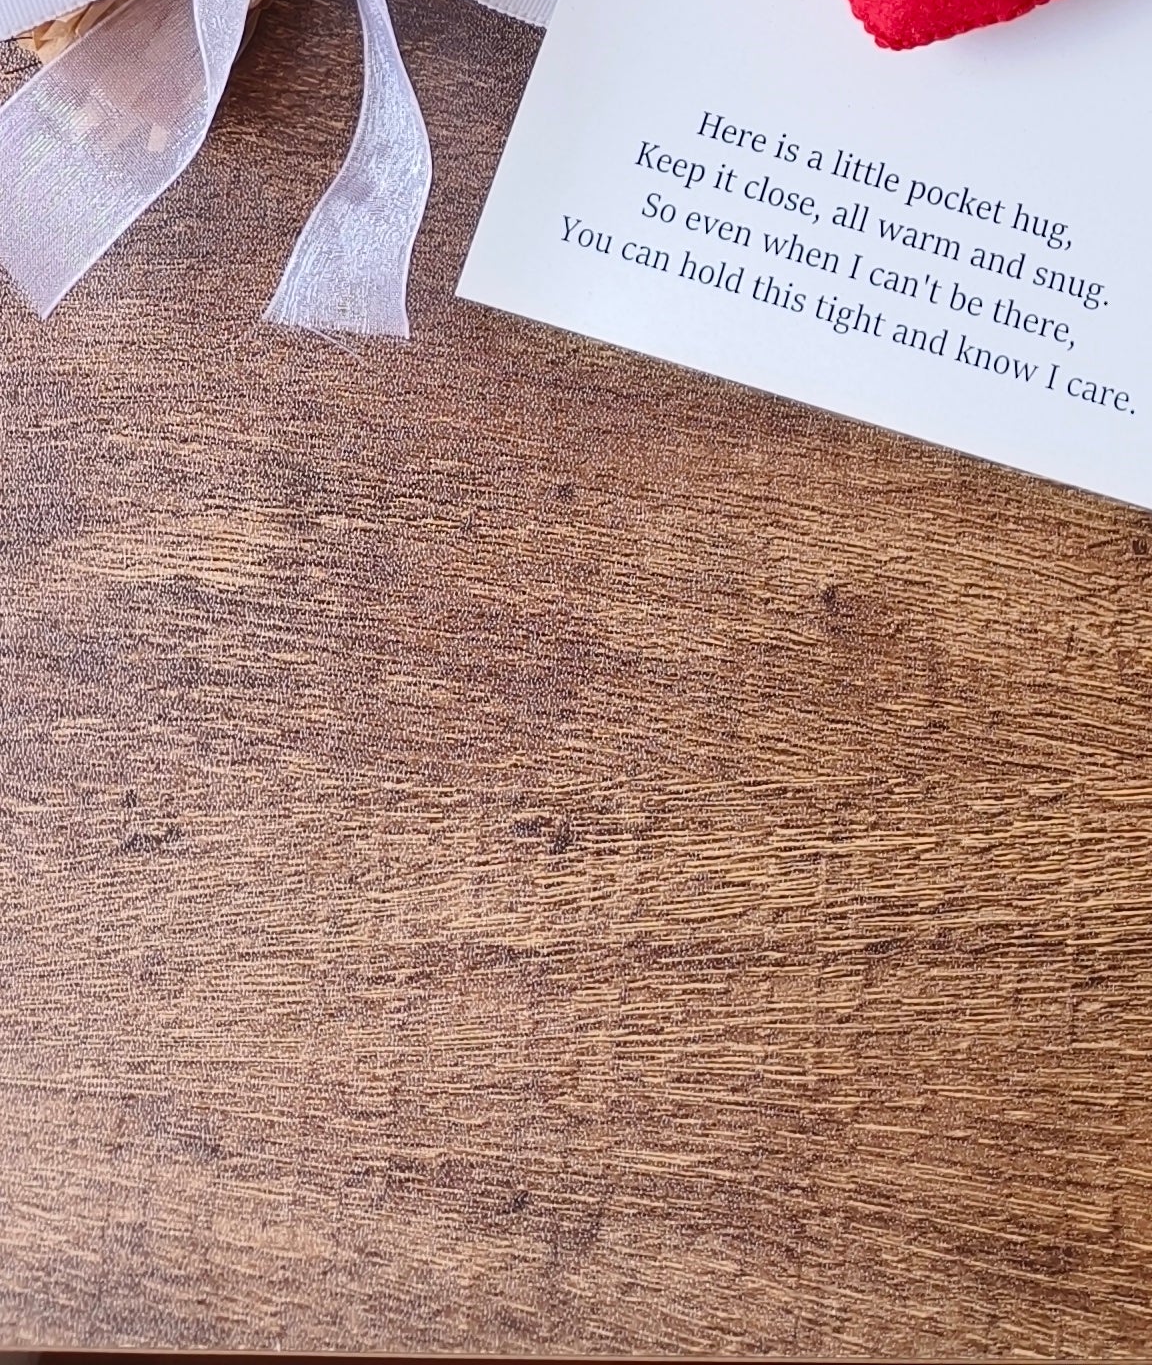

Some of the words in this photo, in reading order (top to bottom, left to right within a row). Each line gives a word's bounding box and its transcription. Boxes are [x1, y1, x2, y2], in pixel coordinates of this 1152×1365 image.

[634, 140, 706, 190] Keep
[713, 163, 738, 193] it
[744, 176, 820, 225] close,
[832, 203, 870, 233] all
[879, 218, 960, 261] warm
[970, 248, 1026, 280] and
[1032, 267, 1108, 310] snug.
[697, 111, 767, 153] Here
[773, 133, 800, 163] is
[807, 150, 823, 171] a
[831, 149, 900, 193] little
[904, 180, 1006, 225] pocket
[1011, 202, 1072, 251] hug,
[561, 215, 613, 254] You
[621, 242, 670, 272] can
[678, 250, 745, 294] hold
[752, 276, 807, 313] this
[815, 295, 882, 337] tight
[892, 324, 949, 357] and
[954, 334, 1039, 382] know
[1046, 364, 1060, 390] I
[1067, 378, 1135, 415] care.
[641, 192, 677, 223] So
[685, 211, 751, 247] even
[764, 233, 839, 274] when
[848, 254, 863, 280] I
[869, 267, 939, 304] can't
[949, 282, 983, 317] be
[993, 299, 1075, 351] there,
